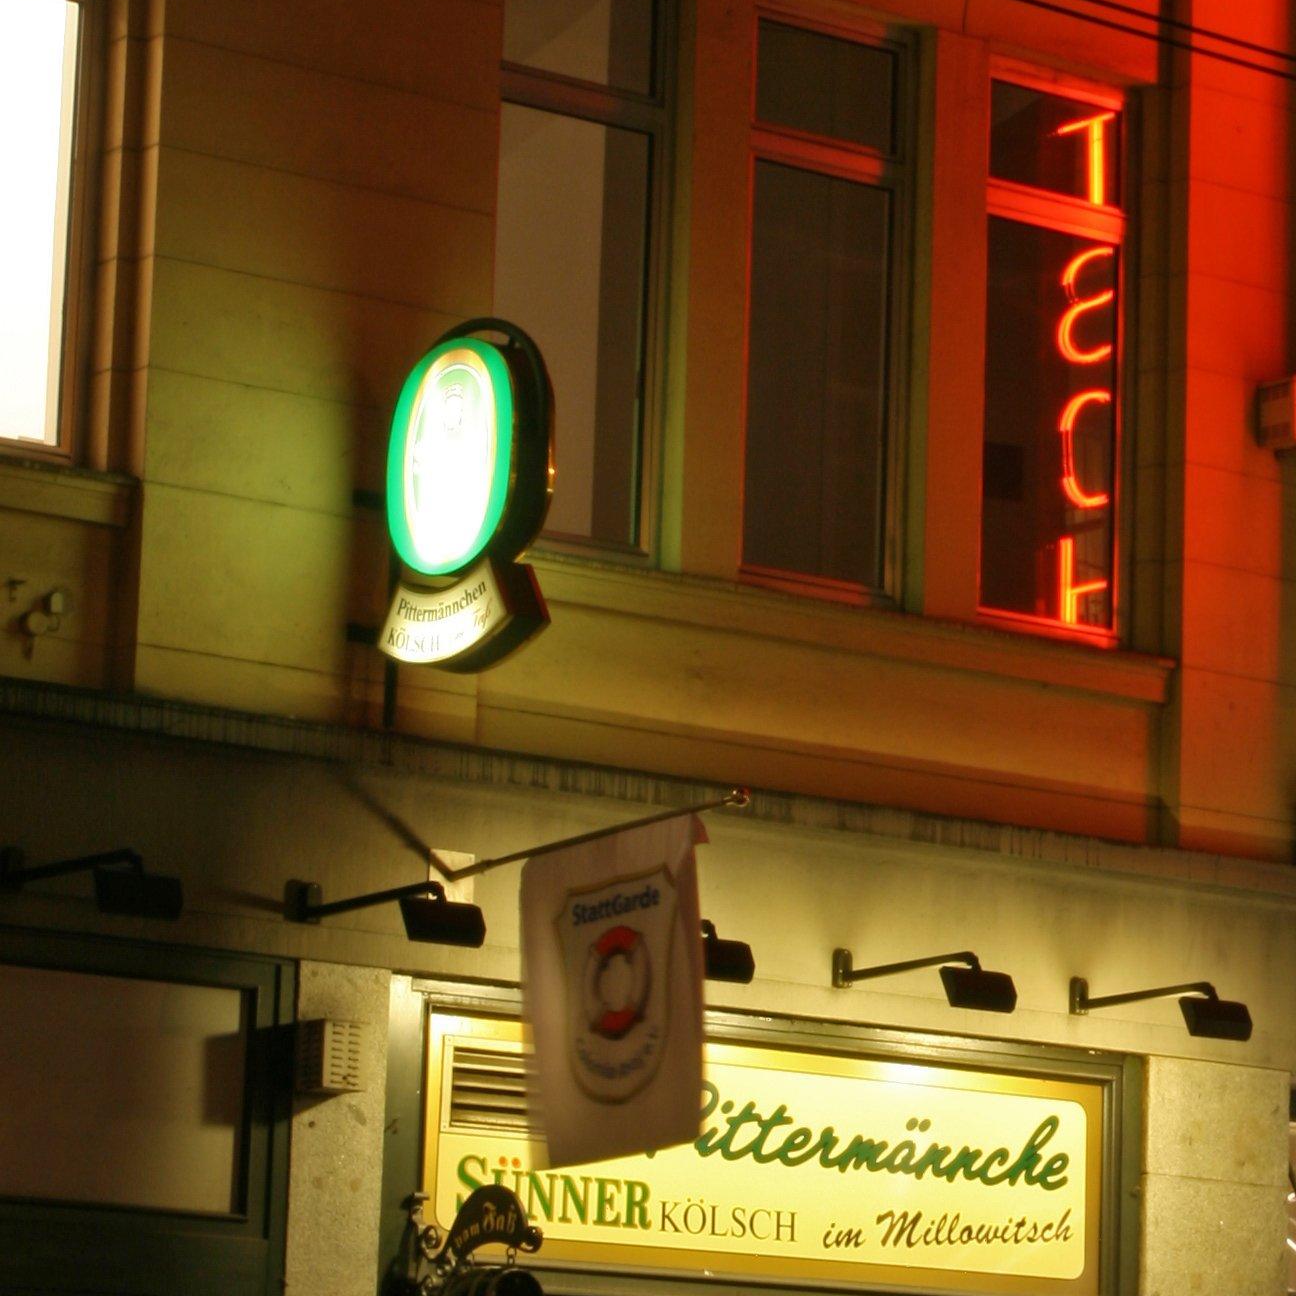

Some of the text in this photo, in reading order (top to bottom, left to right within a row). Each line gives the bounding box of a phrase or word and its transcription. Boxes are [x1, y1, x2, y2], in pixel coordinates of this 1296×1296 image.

[397, 581, 487, 622] Pittermännchen
[571, 885, 661, 926] StattGarde
[660, 1197, 798, 1242] KÖLSCH
[822, 1222, 866, 1249] im
[876, 1208, 1072, 1249] Millowitsch
